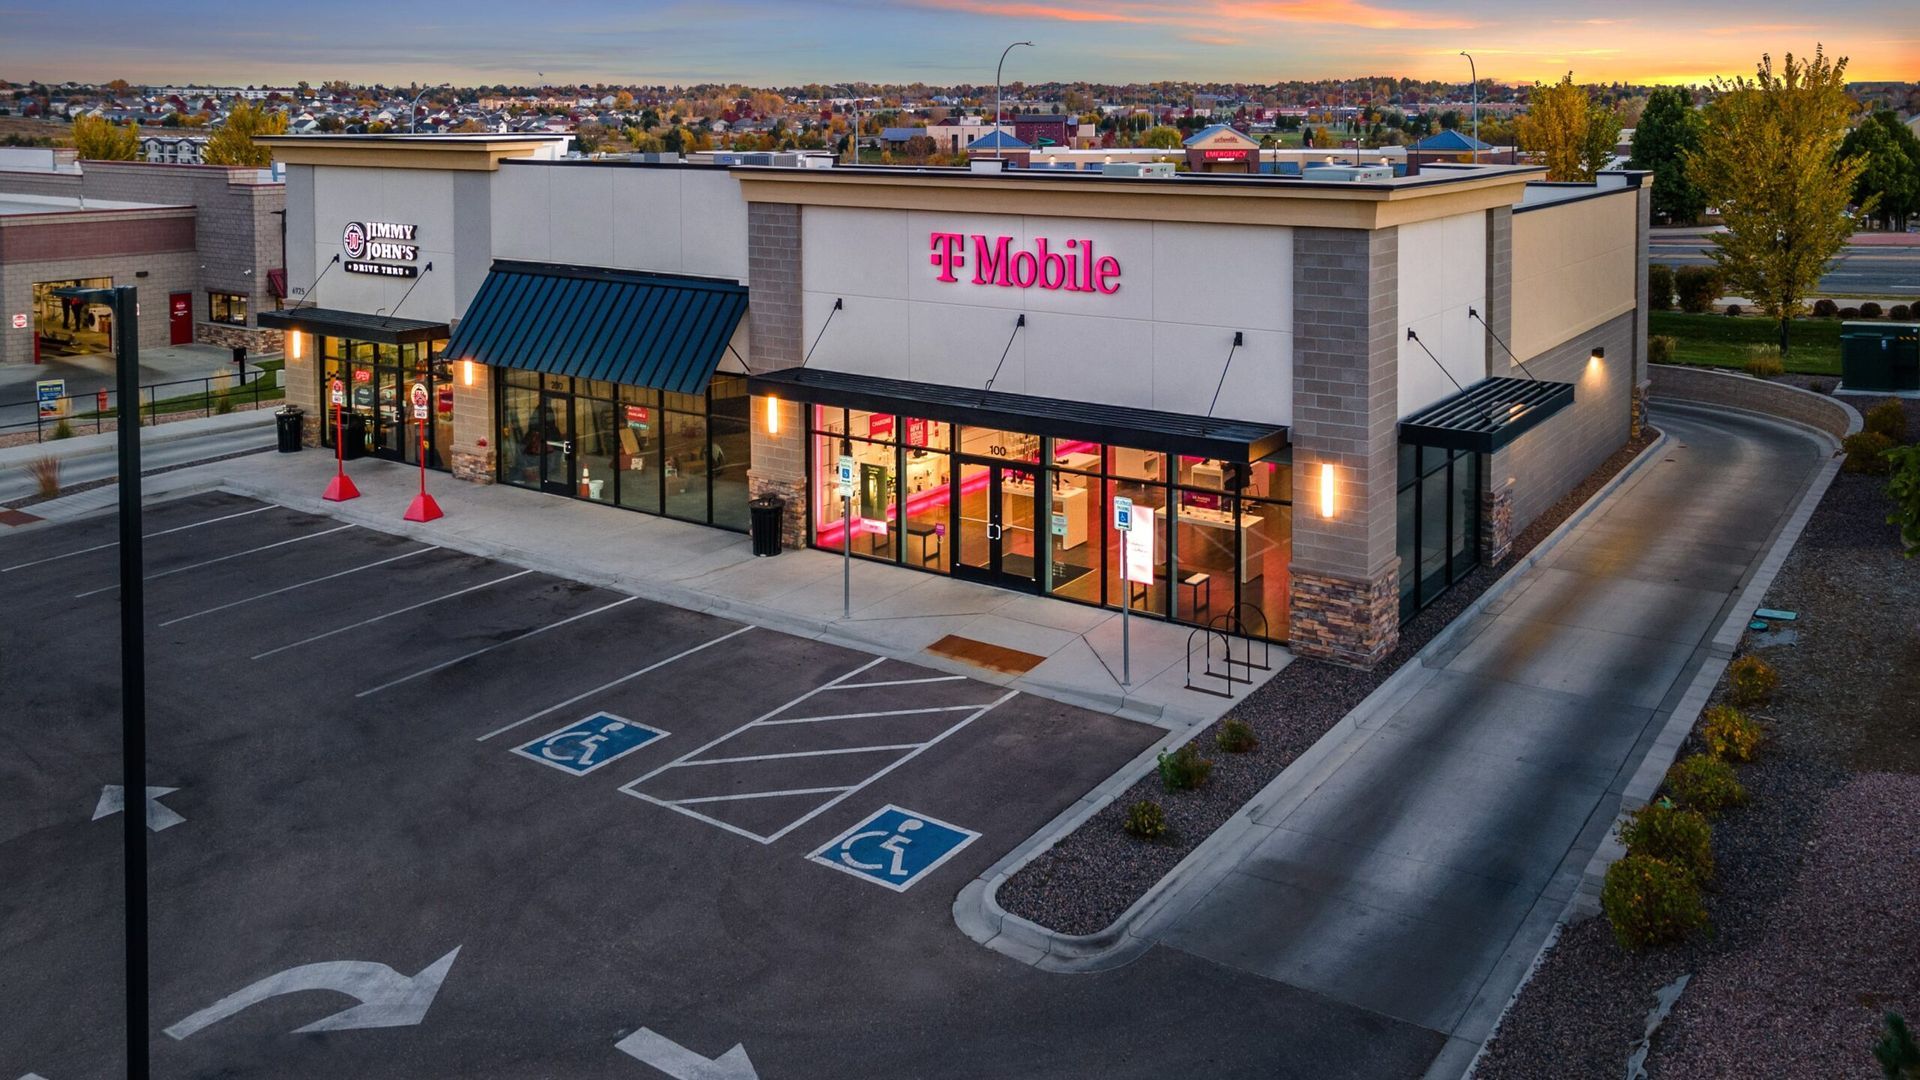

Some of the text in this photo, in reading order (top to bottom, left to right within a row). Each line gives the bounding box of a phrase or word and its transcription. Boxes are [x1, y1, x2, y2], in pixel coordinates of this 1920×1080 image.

[1205, 150, 1248, 158] EMERGENCY
[366, 222, 414, 241] JIMMY
[366, 242, 416, 261] JOHN'S
[353, 263, 404, 276] DRIVE THRU
[971, 234, 1121, 295] Mobile
[990, 445, 1007, 456] 100
